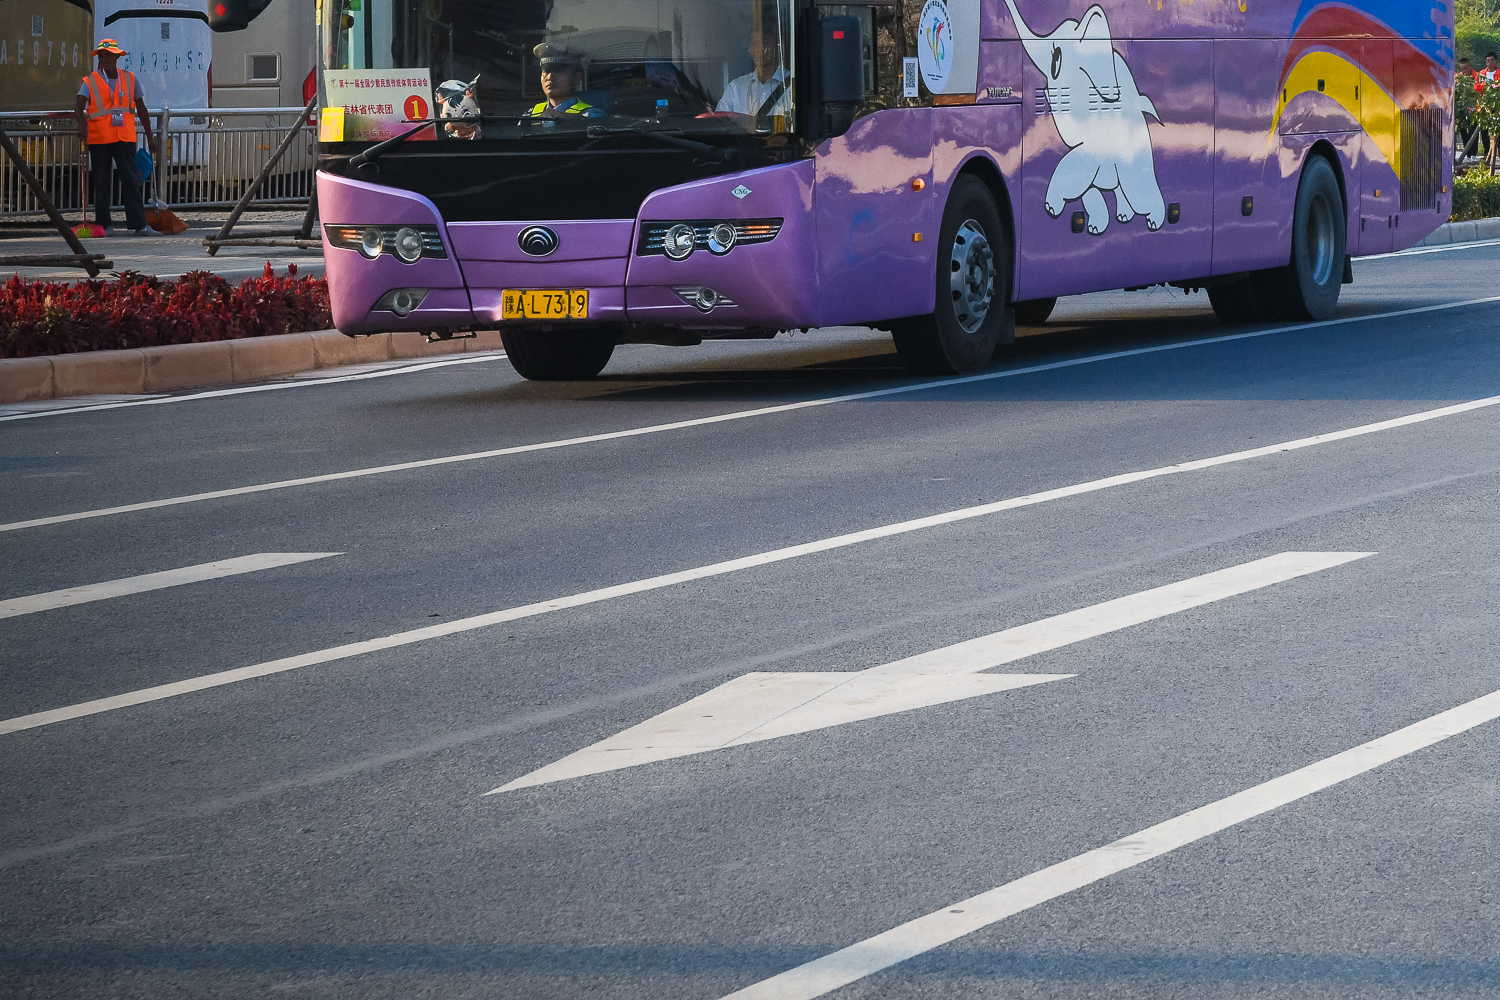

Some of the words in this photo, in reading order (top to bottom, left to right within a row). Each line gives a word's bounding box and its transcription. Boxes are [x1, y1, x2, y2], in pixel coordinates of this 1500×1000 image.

[339, 78, 428, 88] 第十一届全国少数民族传统体育运动会
[341, 104, 394, 115] 吉林省代表团
[411, 100, 422, 119] 1
